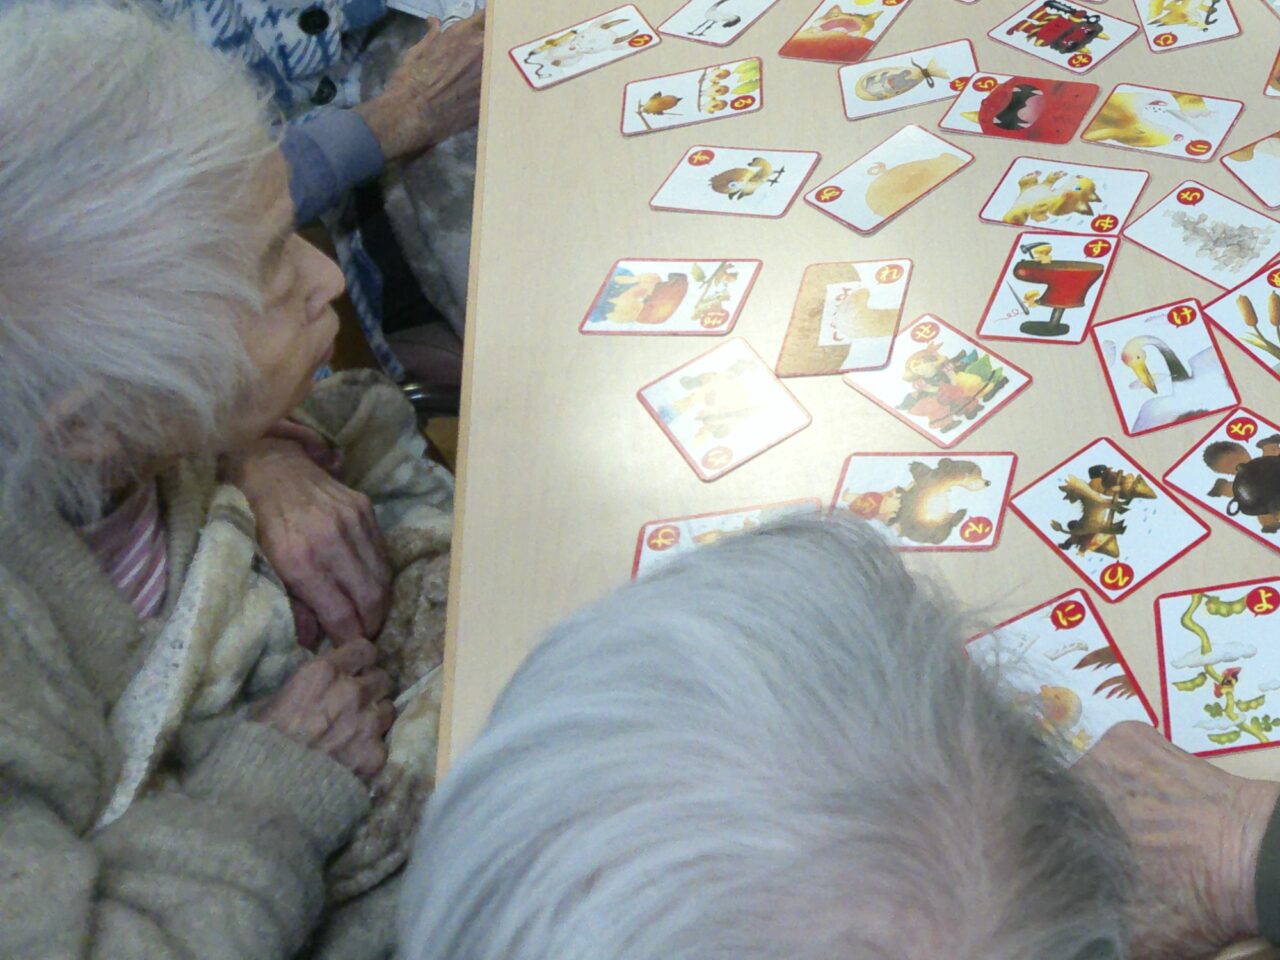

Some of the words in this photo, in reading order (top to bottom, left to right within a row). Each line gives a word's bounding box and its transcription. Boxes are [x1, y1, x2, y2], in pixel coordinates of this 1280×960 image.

[1156, 34, 1173, 45] ひ
[1072, 55, 1088, 67] お
[976, 79, 994, 88] ら
[734, 98, 752, 107] る
[1189, 144, 1208, 152] り
[692, 151, 709, 162] す
[1180, 191, 1200, 200] ち
[1095, 216, 1113, 230] せ
[1088, 240, 1108, 256] す
[879, 266, 899, 281] れ
[703, 311, 724, 325] ほ
[1172, 307, 1191, 324] け
[915, 325, 935, 339] せ
[1230, 422, 1254, 435] ち
[651, 527, 675, 546] わ
[964, 522, 989, 537] え
[1104, 566, 1128, 586] ろ
[1253, 589, 1273, 612] よ
[1056, 604, 1082, 625] に
